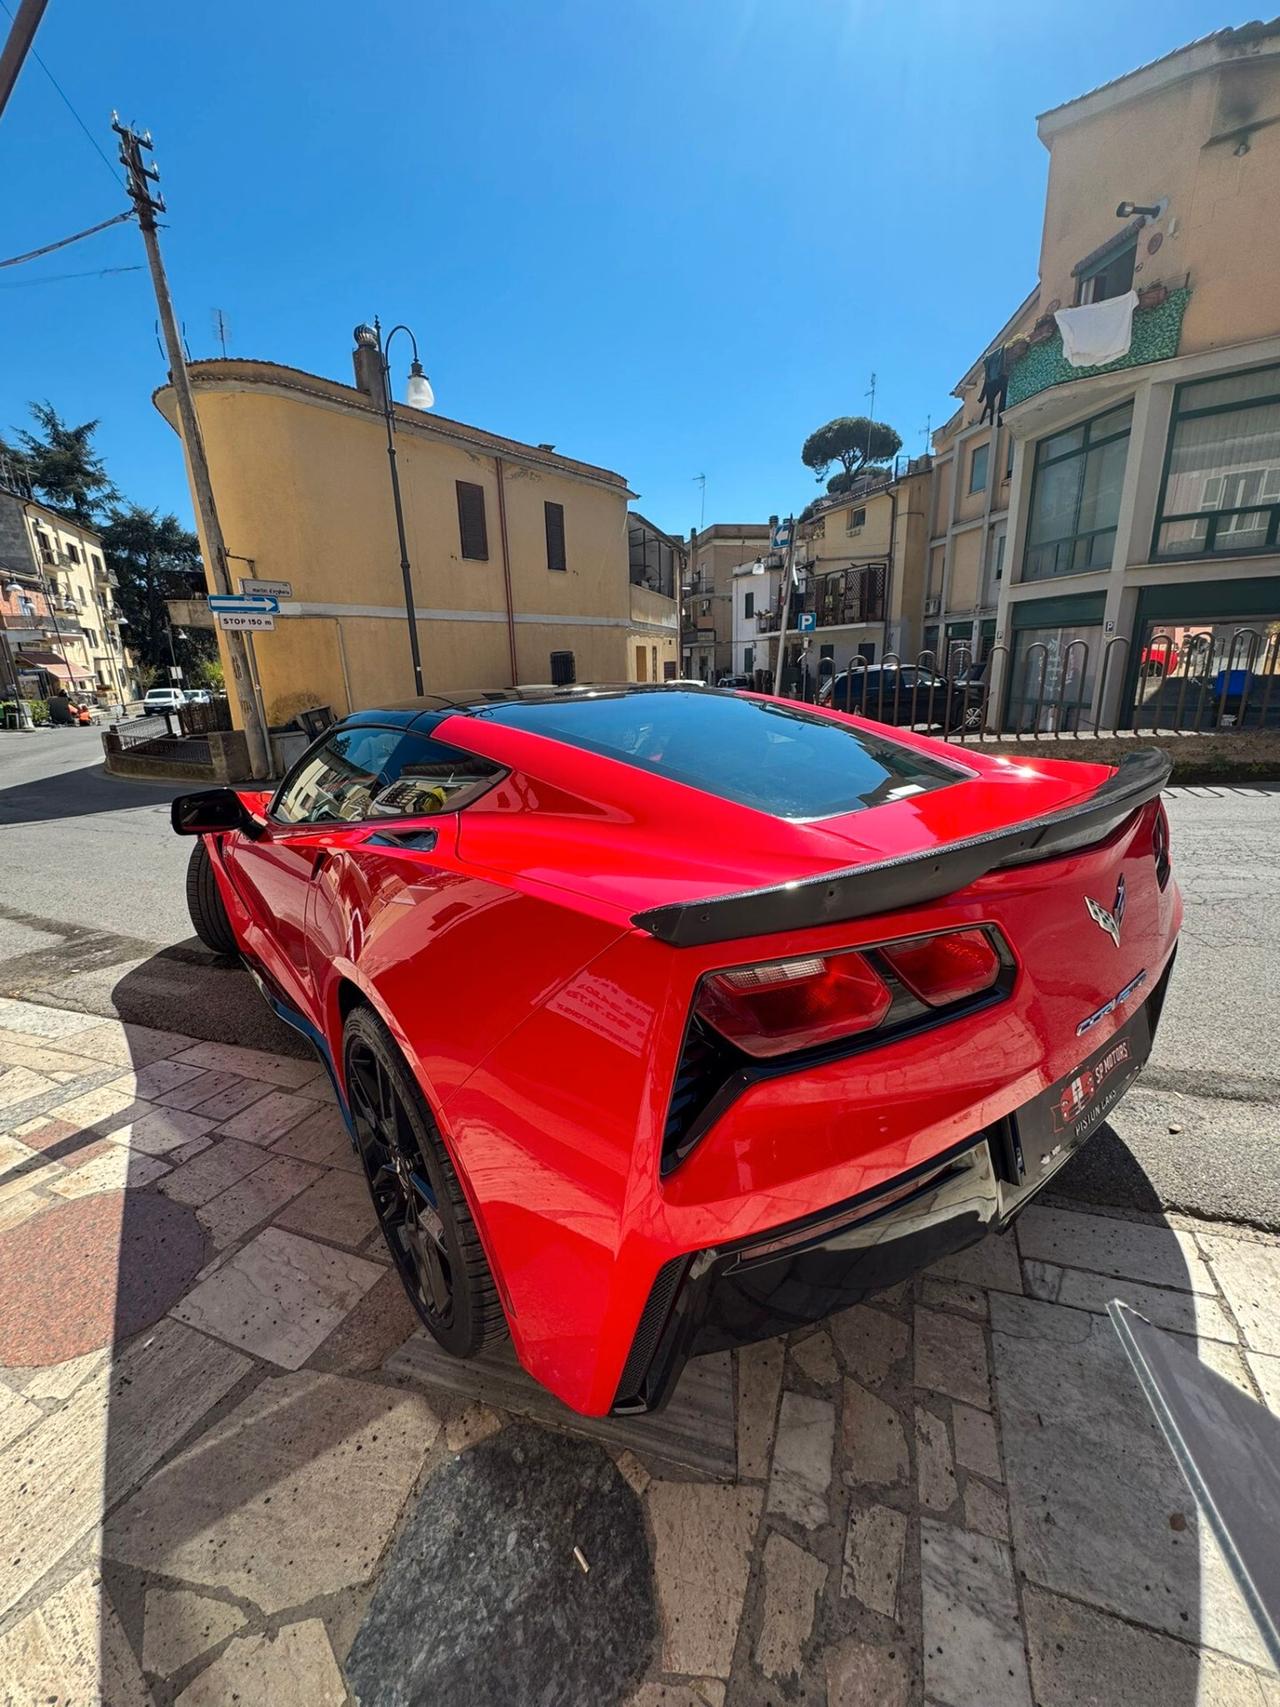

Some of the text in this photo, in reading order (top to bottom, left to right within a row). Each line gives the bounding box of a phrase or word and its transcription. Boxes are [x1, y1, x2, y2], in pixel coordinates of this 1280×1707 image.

[248, 618, 262, 626] 150
[801, 615, 813, 630] P
[1094, 1041, 1128, 1084] SP MOTORS
